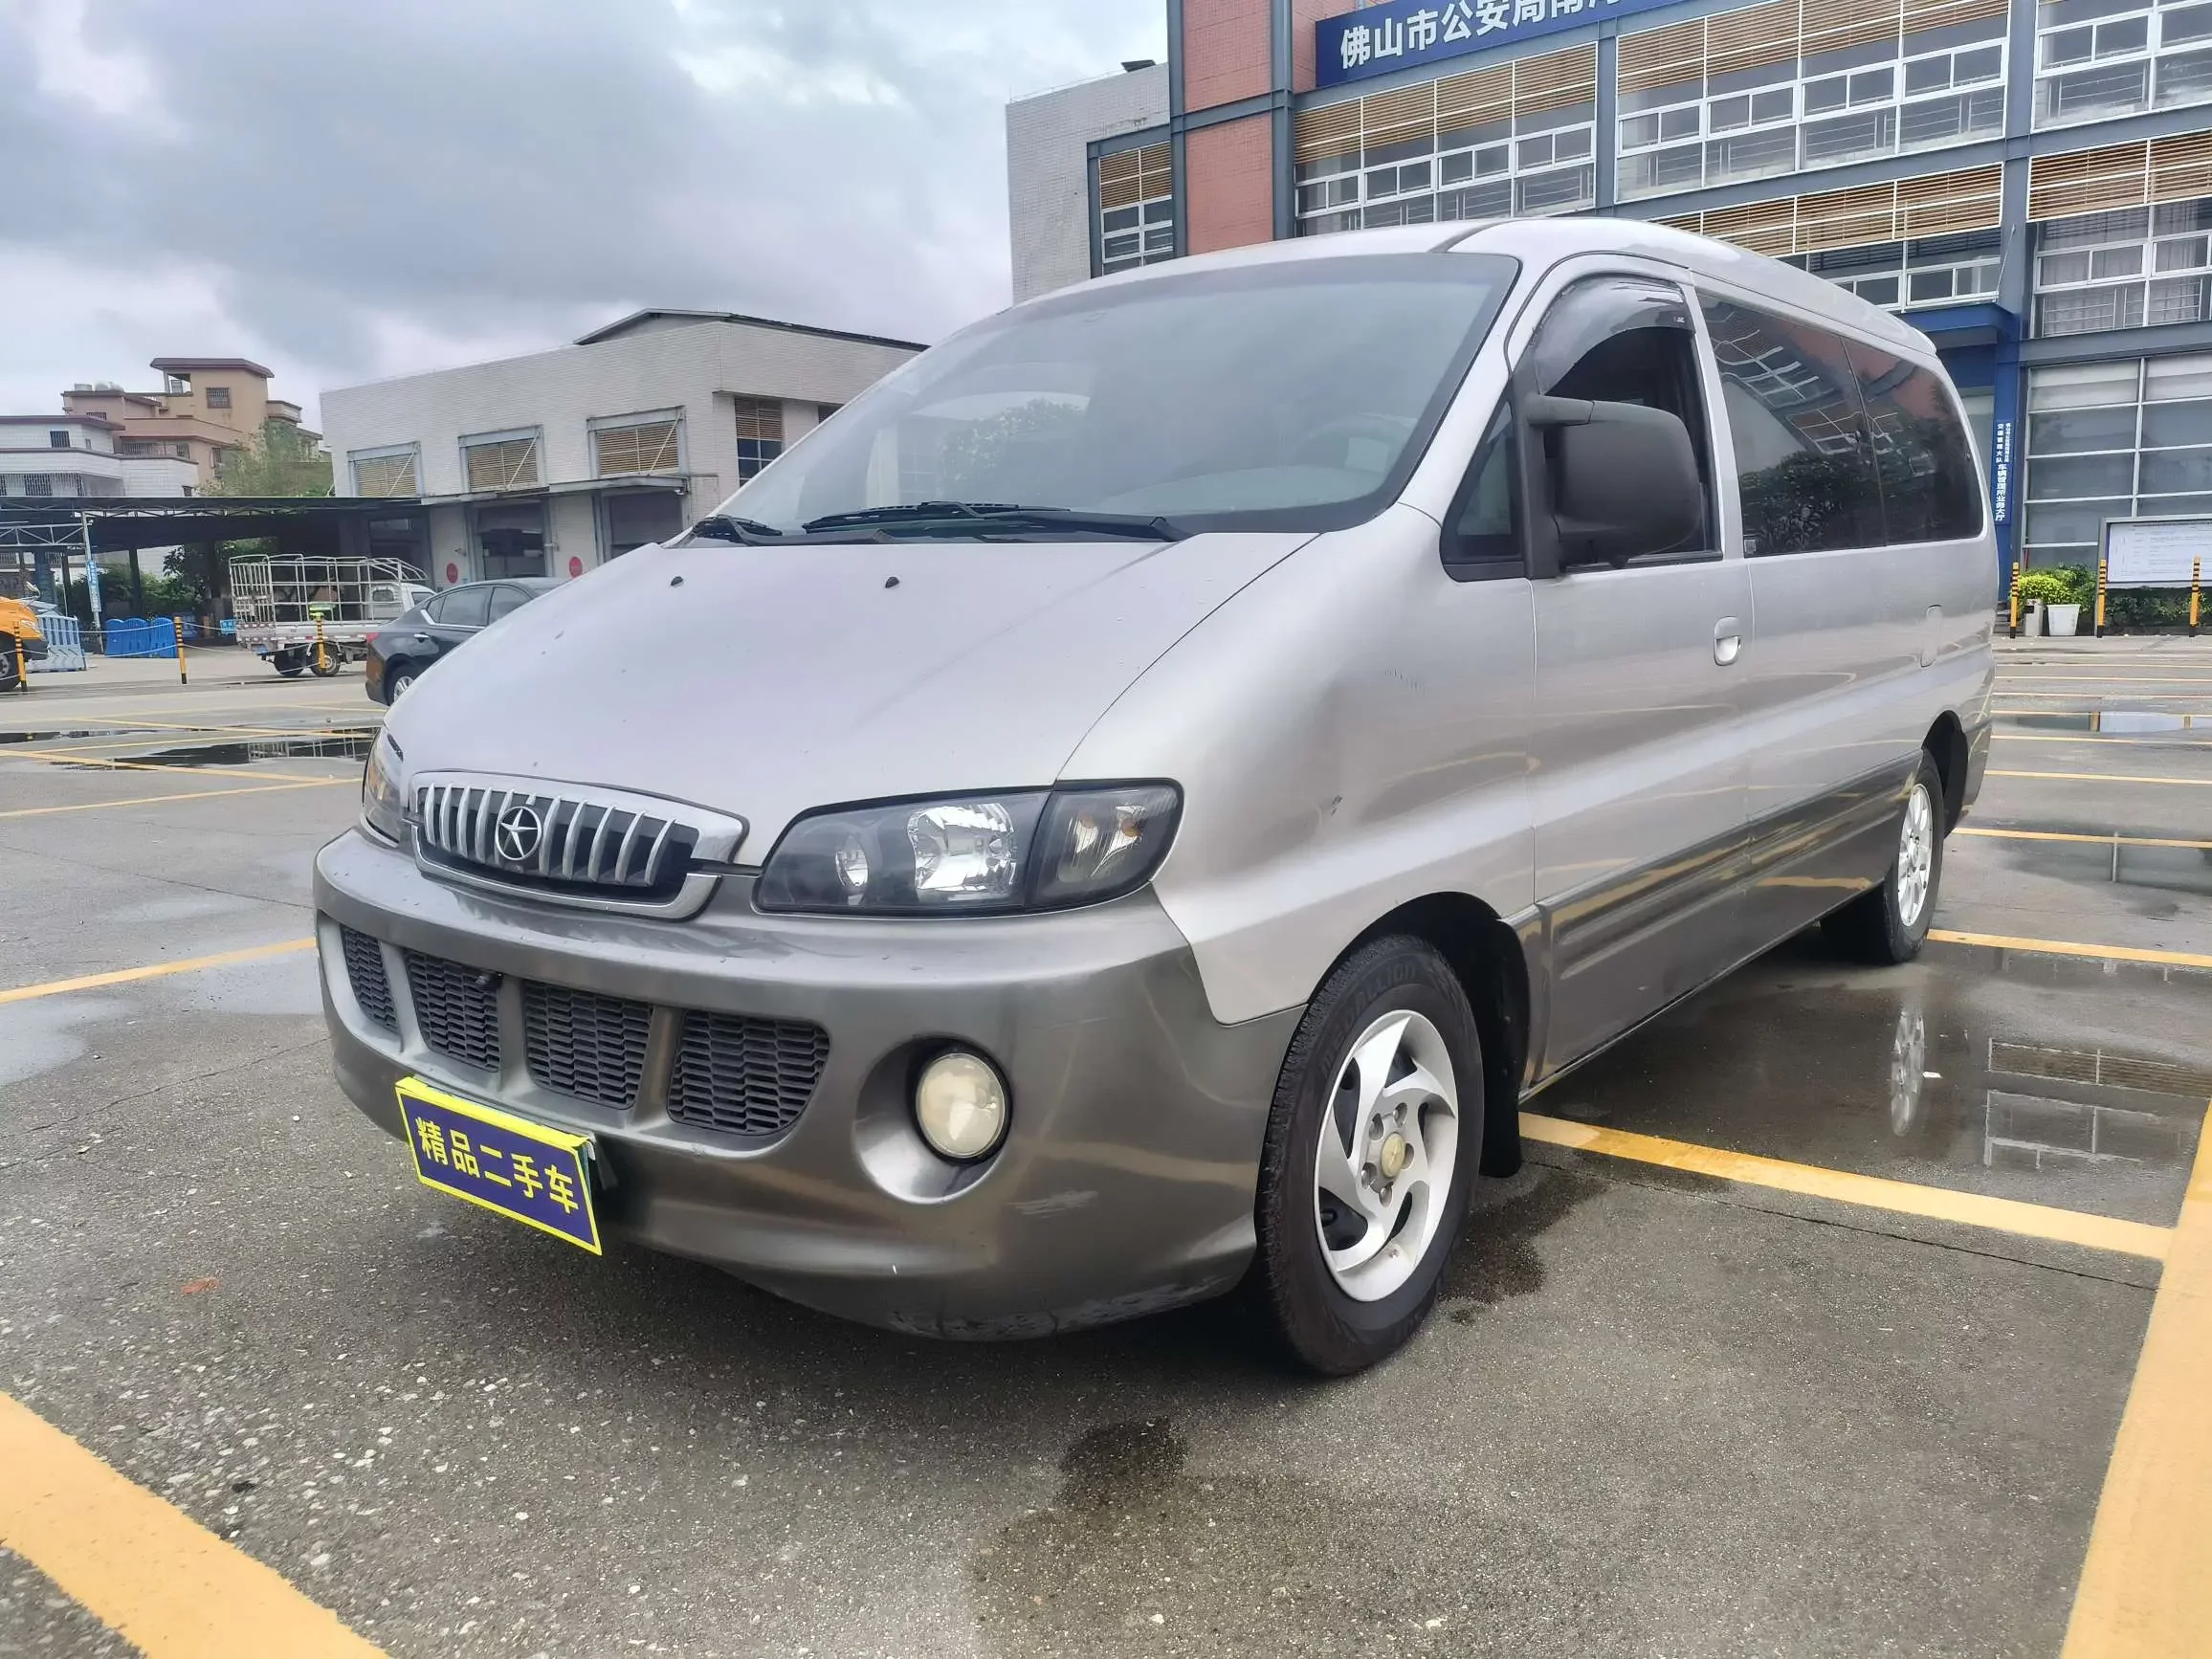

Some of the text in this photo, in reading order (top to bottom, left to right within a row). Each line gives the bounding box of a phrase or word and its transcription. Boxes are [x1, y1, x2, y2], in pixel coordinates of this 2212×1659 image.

[1340, 0, 1619, 69] 佛山市公安局
[415, 1116, 579, 1213] 精品二手车
